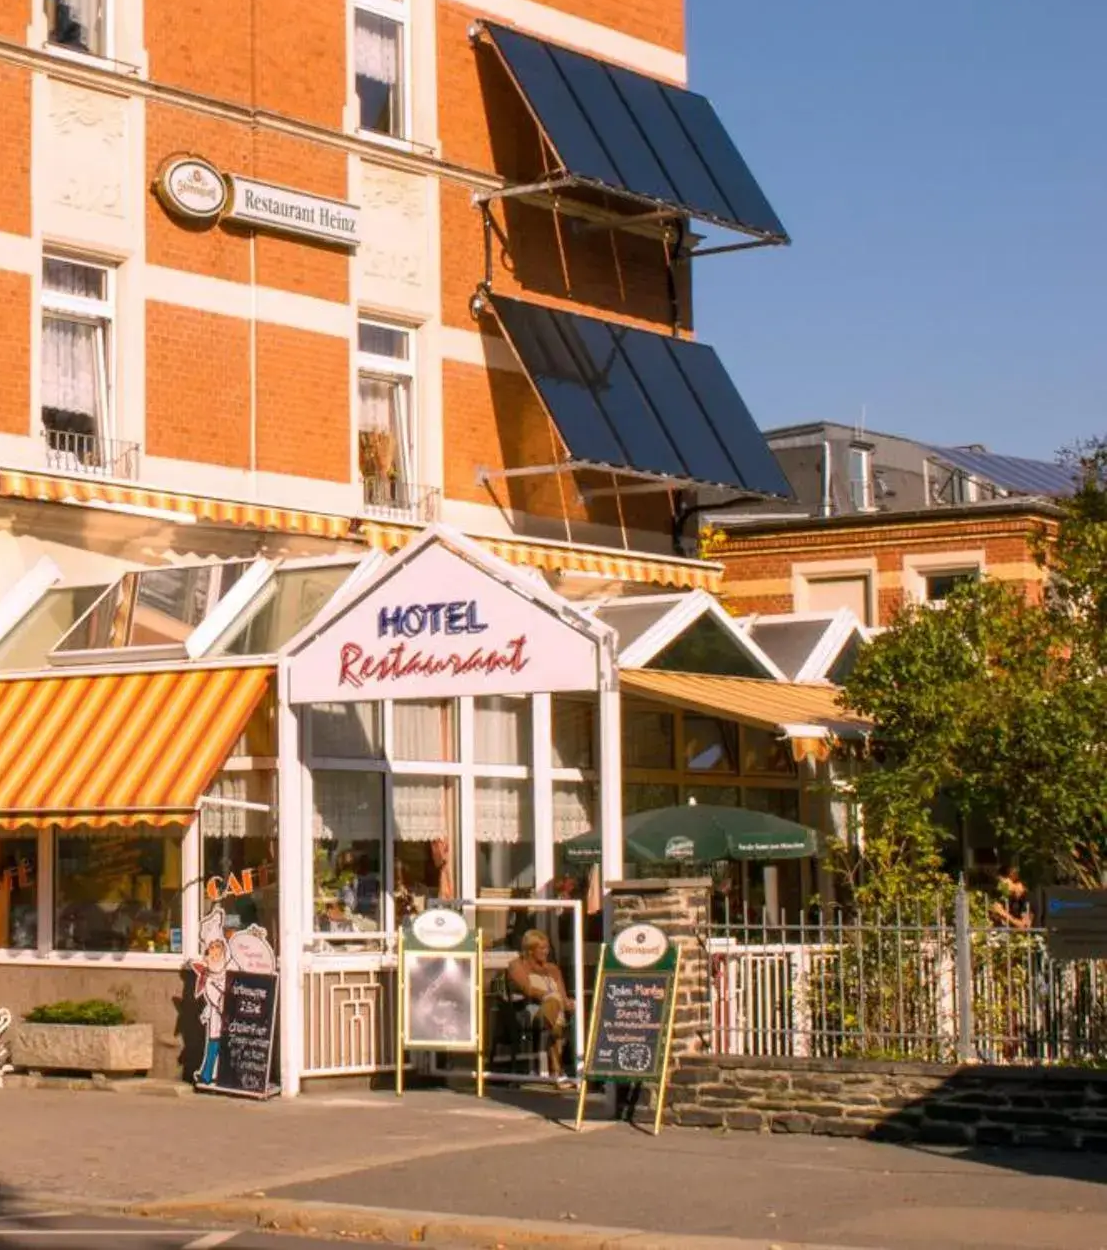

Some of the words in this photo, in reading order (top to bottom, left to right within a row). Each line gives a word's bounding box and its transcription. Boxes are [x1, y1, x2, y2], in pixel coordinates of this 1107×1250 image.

[244, 188, 315, 227] Restaurant
[319, 206, 357, 234] Heinz
[377, 599, 489, 638] HOTEL
[338, 634, 532, 689] Restaurant
